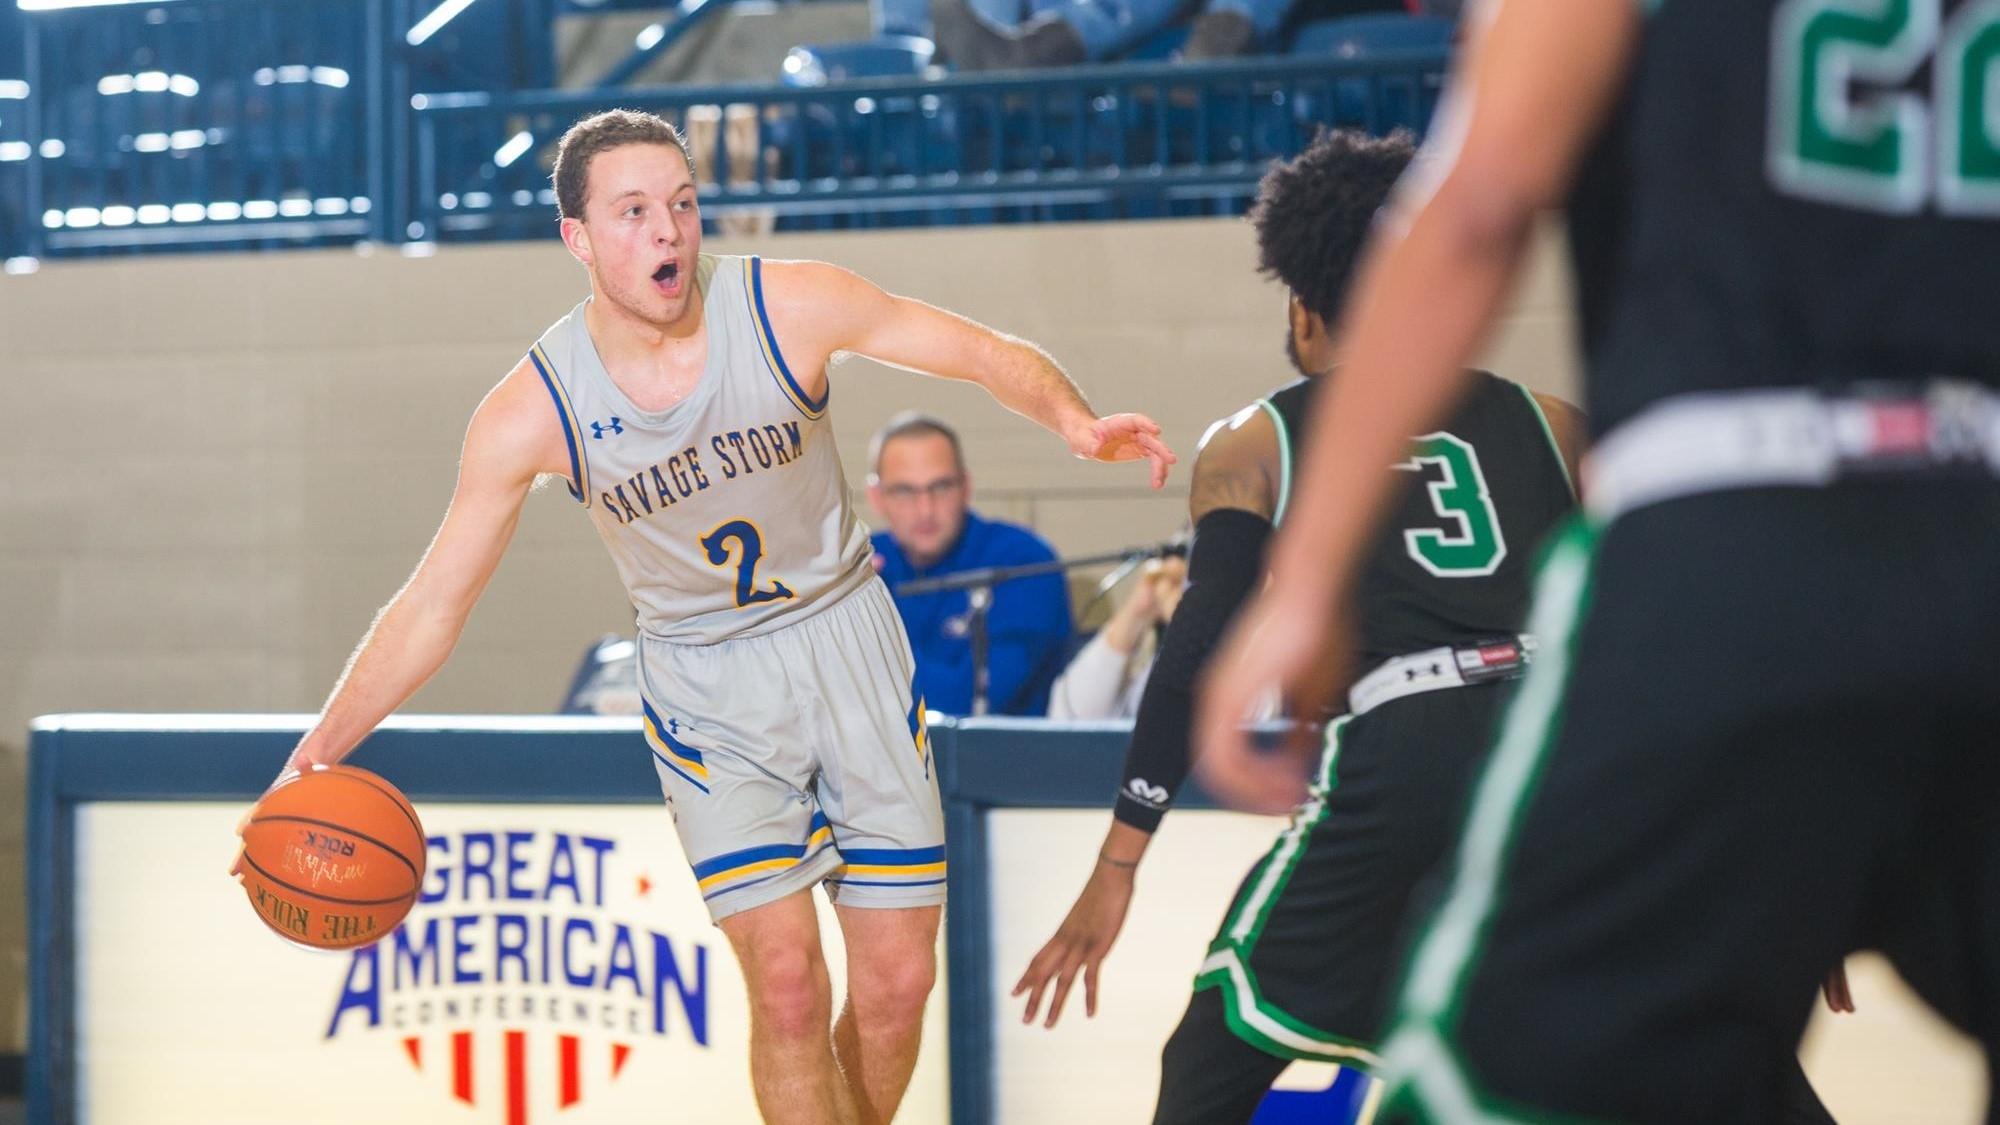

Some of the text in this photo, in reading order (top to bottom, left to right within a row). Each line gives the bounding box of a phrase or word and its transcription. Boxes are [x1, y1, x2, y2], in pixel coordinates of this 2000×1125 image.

[601, 420, 803, 524] SAVAGE STORM
[699, 515, 799, 609] 2
[303, 830, 356, 857] ROCK
[417, 831, 616, 906] GREAT
[256, 883, 377, 941] THE ROCK
[325, 913, 710, 1048] AMERICAN
[393, 996, 642, 1034] CONFERENCE
